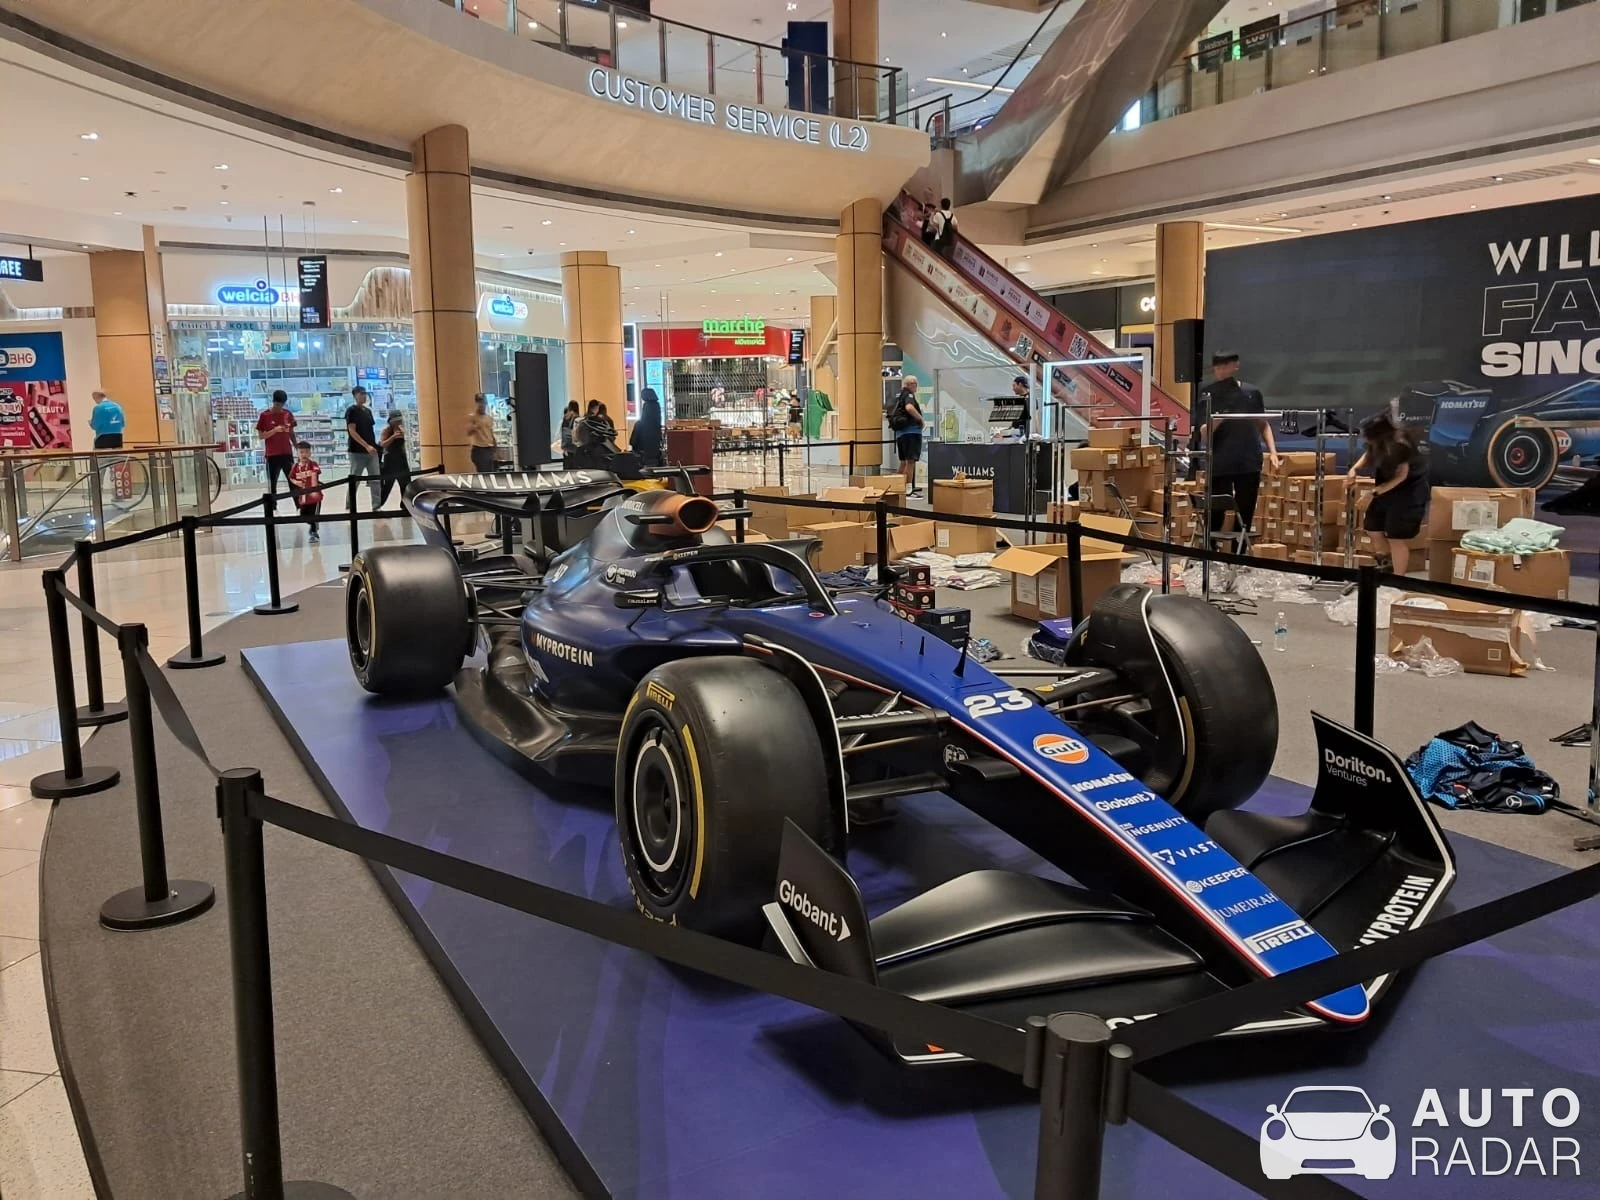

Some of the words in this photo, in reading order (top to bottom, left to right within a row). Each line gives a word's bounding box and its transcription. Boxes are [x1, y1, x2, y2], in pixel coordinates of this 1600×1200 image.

[589, 67, 716, 125] CUSTOMER
[726, 104, 821, 143] SERVICE
[829, 121, 869, 151] (L2)
[221, 285, 274, 303] welcia
[702, 315, 765, 333] marché
[1440, 399, 1486, 409] KOMATSU
[448, 470, 593, 489] WILLIAMS
[951, 466, 995, 478] WILLIAMS
[536, 632, 593, 667] MYPROTEIN
[646, 681, 676, 711] PIRELLI
[963, 689, 1033, 720] 23
[1039, 741, 1083, 756] Gulf
[1071, 772, 1135, 792] KOMATSU
[1326, 764, 1368, 787] Ventures
[1096, 791, 1148, 812] Globant
[1125, 816, 1188, 839] INGENUITY
[1176, 840, 1218, 859] VAST
[1200, 866, 1249, 888] KEEPER
[779, 879, 839, 936] Globant
[1213, 893, 1279, 922] JUMEIRAH
[1243, 919, 1315, 954] PIRELLI
